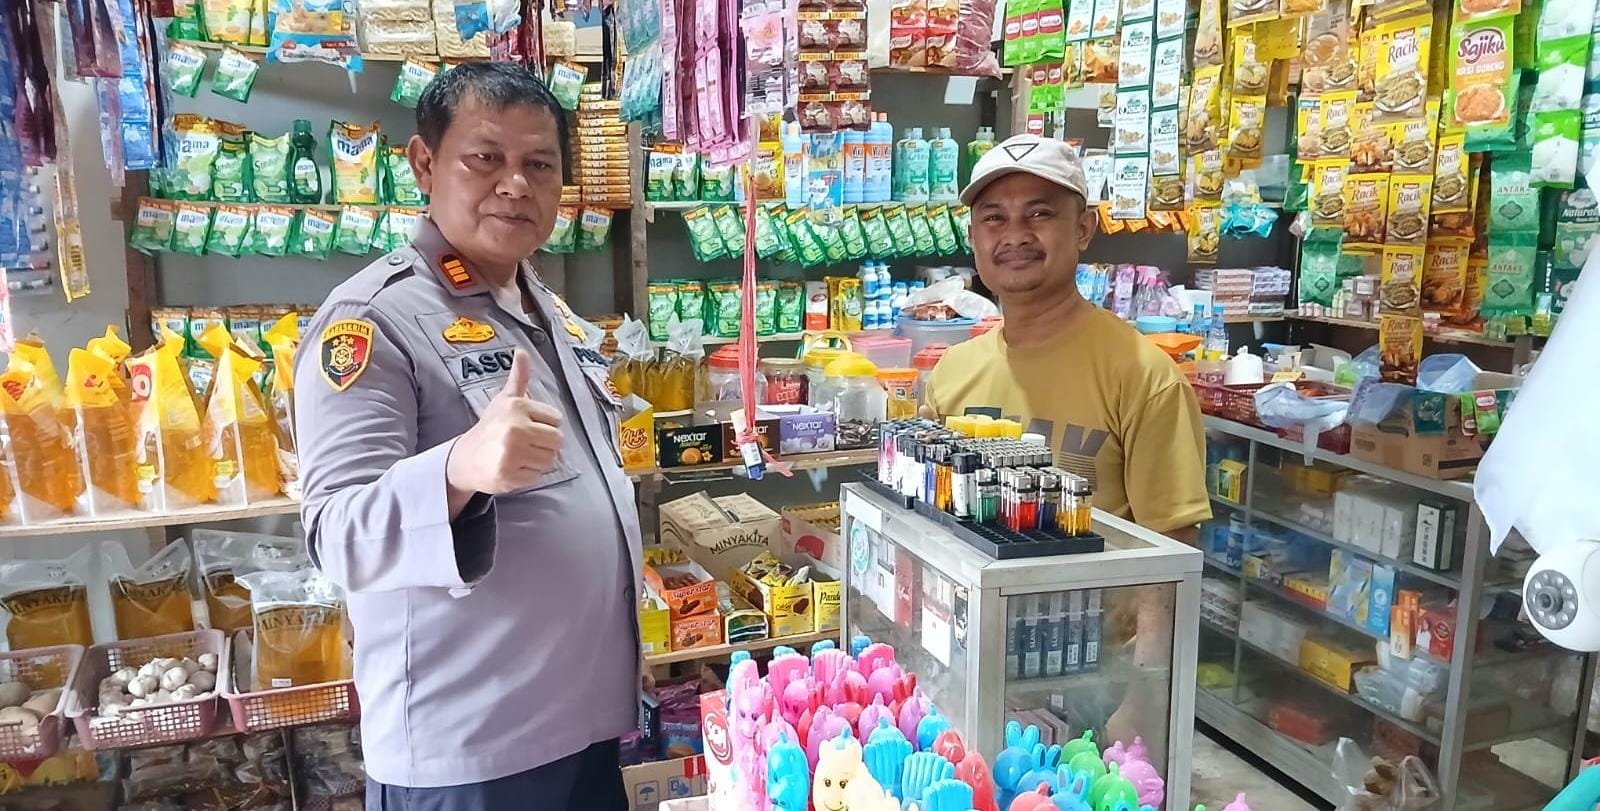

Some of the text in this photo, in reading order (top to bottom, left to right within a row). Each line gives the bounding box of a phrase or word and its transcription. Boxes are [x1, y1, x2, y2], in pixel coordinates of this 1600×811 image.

[1387, 37, 1419, 64] Racik
[1457, 34, 1505, 64] Sajiku
[181, 138, 210, 154] ama
[336, 134, 375, 157] mama
[461, 350, 516, 379] ASD
[673, 432, 708, 444] Nextar
[792, 420, 823, 432] Nextar
[709, 529, 769, 555] MINYAKITA
